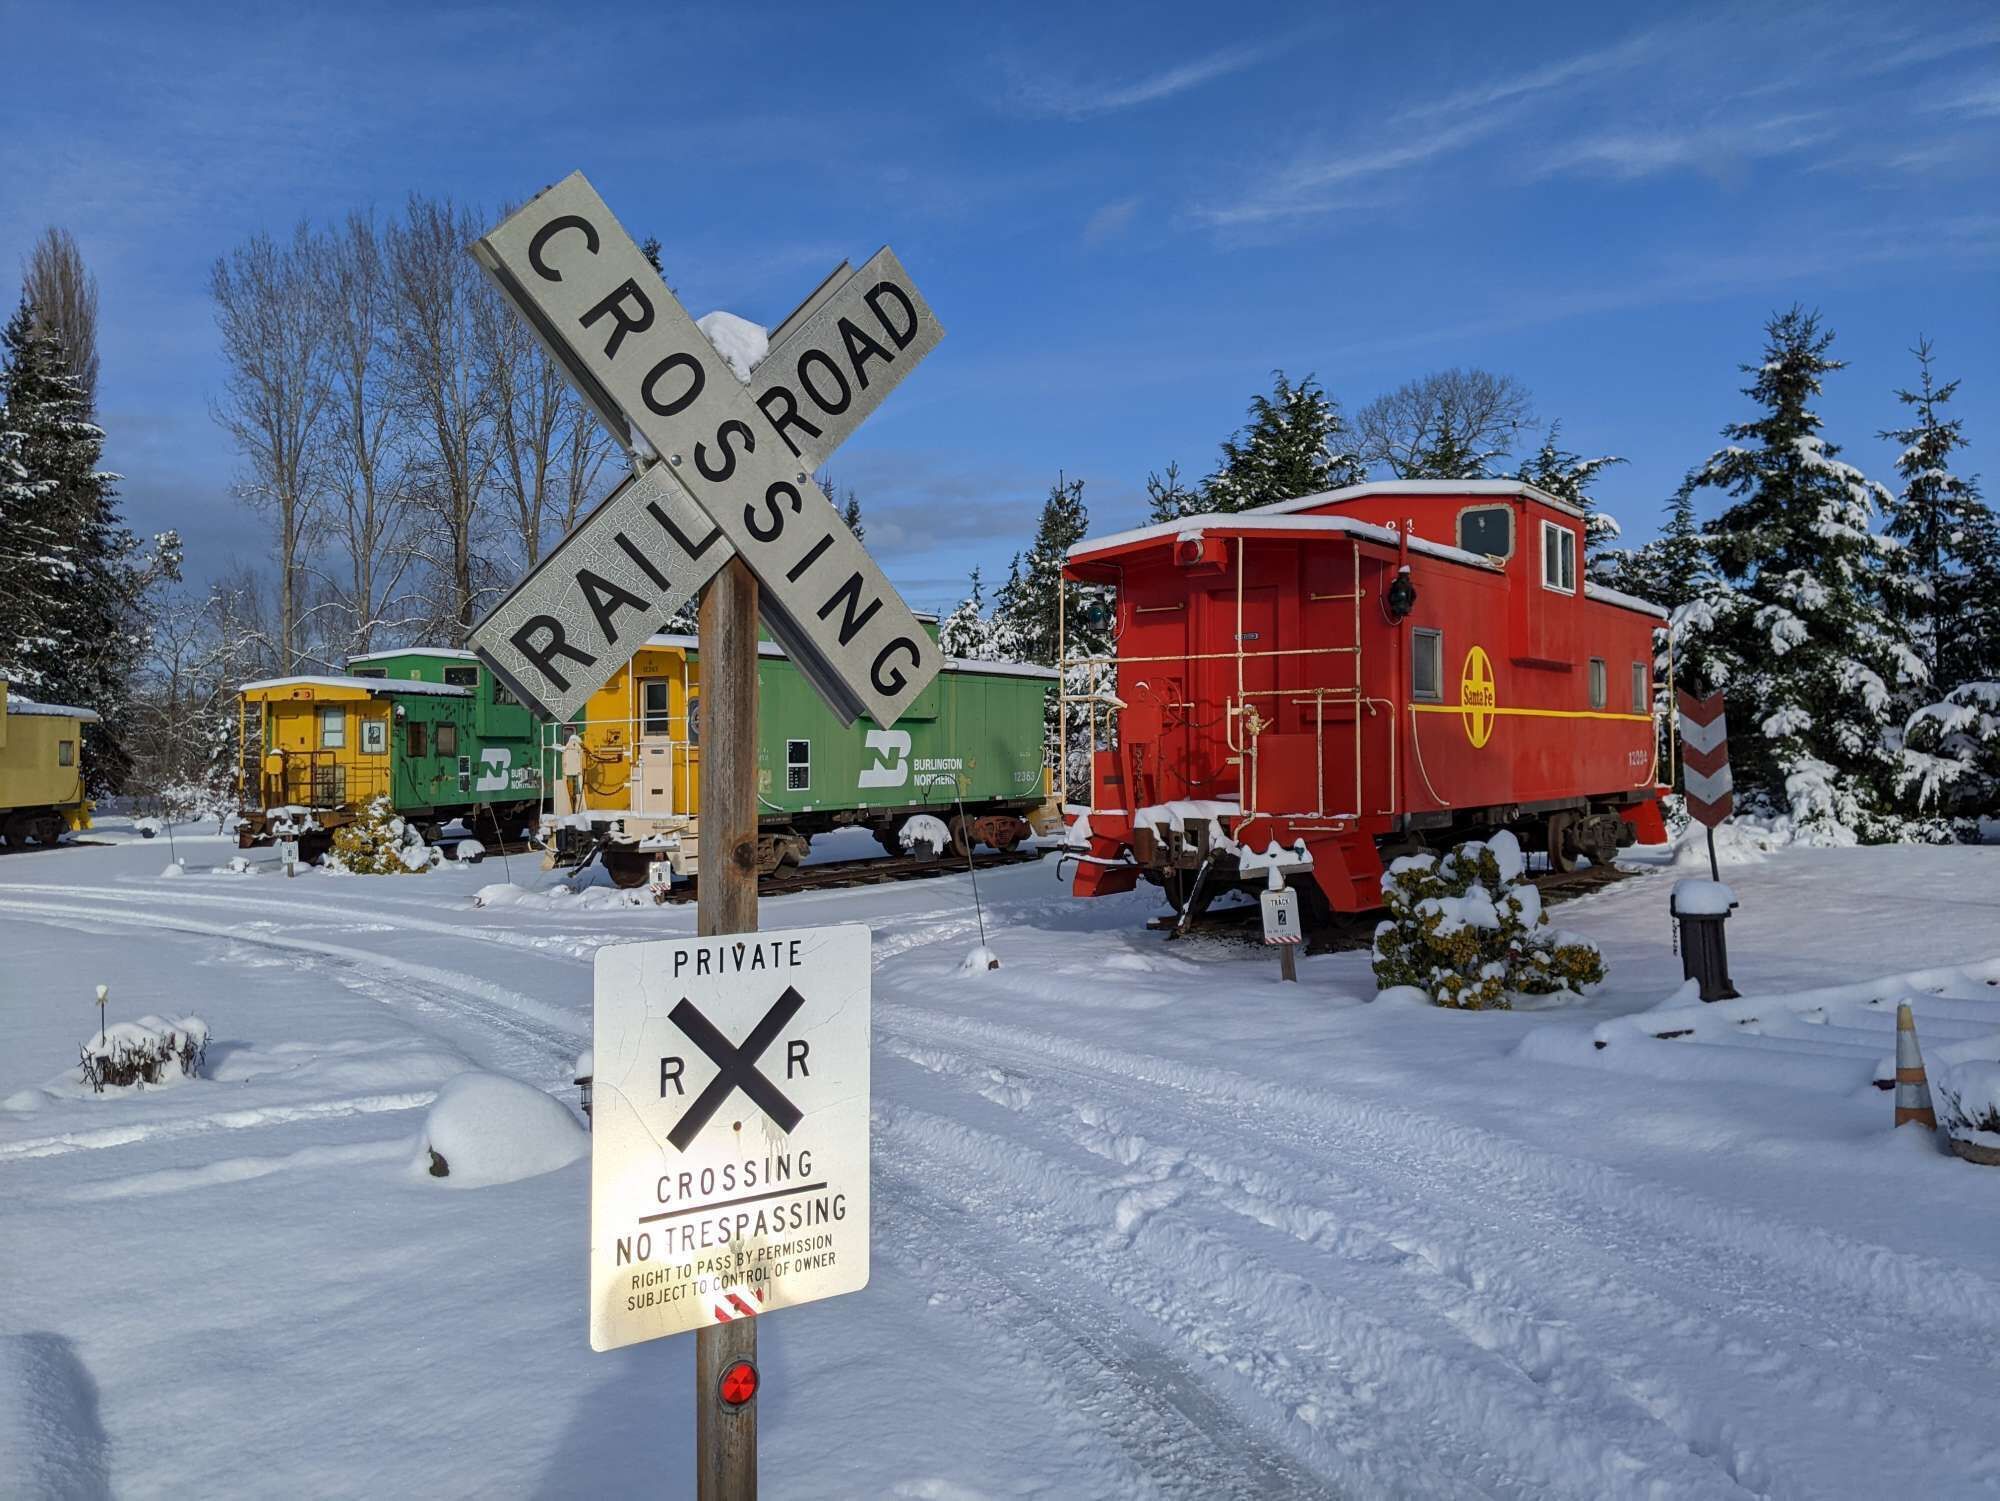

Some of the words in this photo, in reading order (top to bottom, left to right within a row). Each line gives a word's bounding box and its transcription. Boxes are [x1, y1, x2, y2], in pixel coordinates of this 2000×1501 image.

[528, 214, 921, 697] CROSSING
[509, 500, 722, 694] RAIL
[756, 281, 919, 458] ROAD
[1464, 685, 1483, 706] Santa
[1484, 687, 1493, 706] Fe
[913, 758, 963, 771] BURLINGTON
[913, 773, 956, 786] NORTHERN
[1270, 897, 1290, 907] TRACK
[1278, 910, 1286, 925] 2
[674, 940, 802, 978] PRIVATE
[660, 1056, 685, 1098] R
[787, 1039, 810, 1080] R
[657, 1150, 812, 1204] CROSSING
[616, 1232, 651, 1266] NO
[665, 1194, 846, 1255] TRESPASSING
[627, 1285, 686, 1311] SUBJECT
[692, 1279, 707, 1294] TO
[713, 1268, 770, 1292] CONTROL
[775, 1260, 790, 1277] OF
[795, 1251, 836, 1271] OWNER
[632, 1265, 672, 1290] RIGHT
[676, 1262, 692, 1280] TO
[697, 1254, 731, 1275] PASS
[737, 1251, 753, 1267] BY
[758, 1233, 833, 1262] PERMISSION
